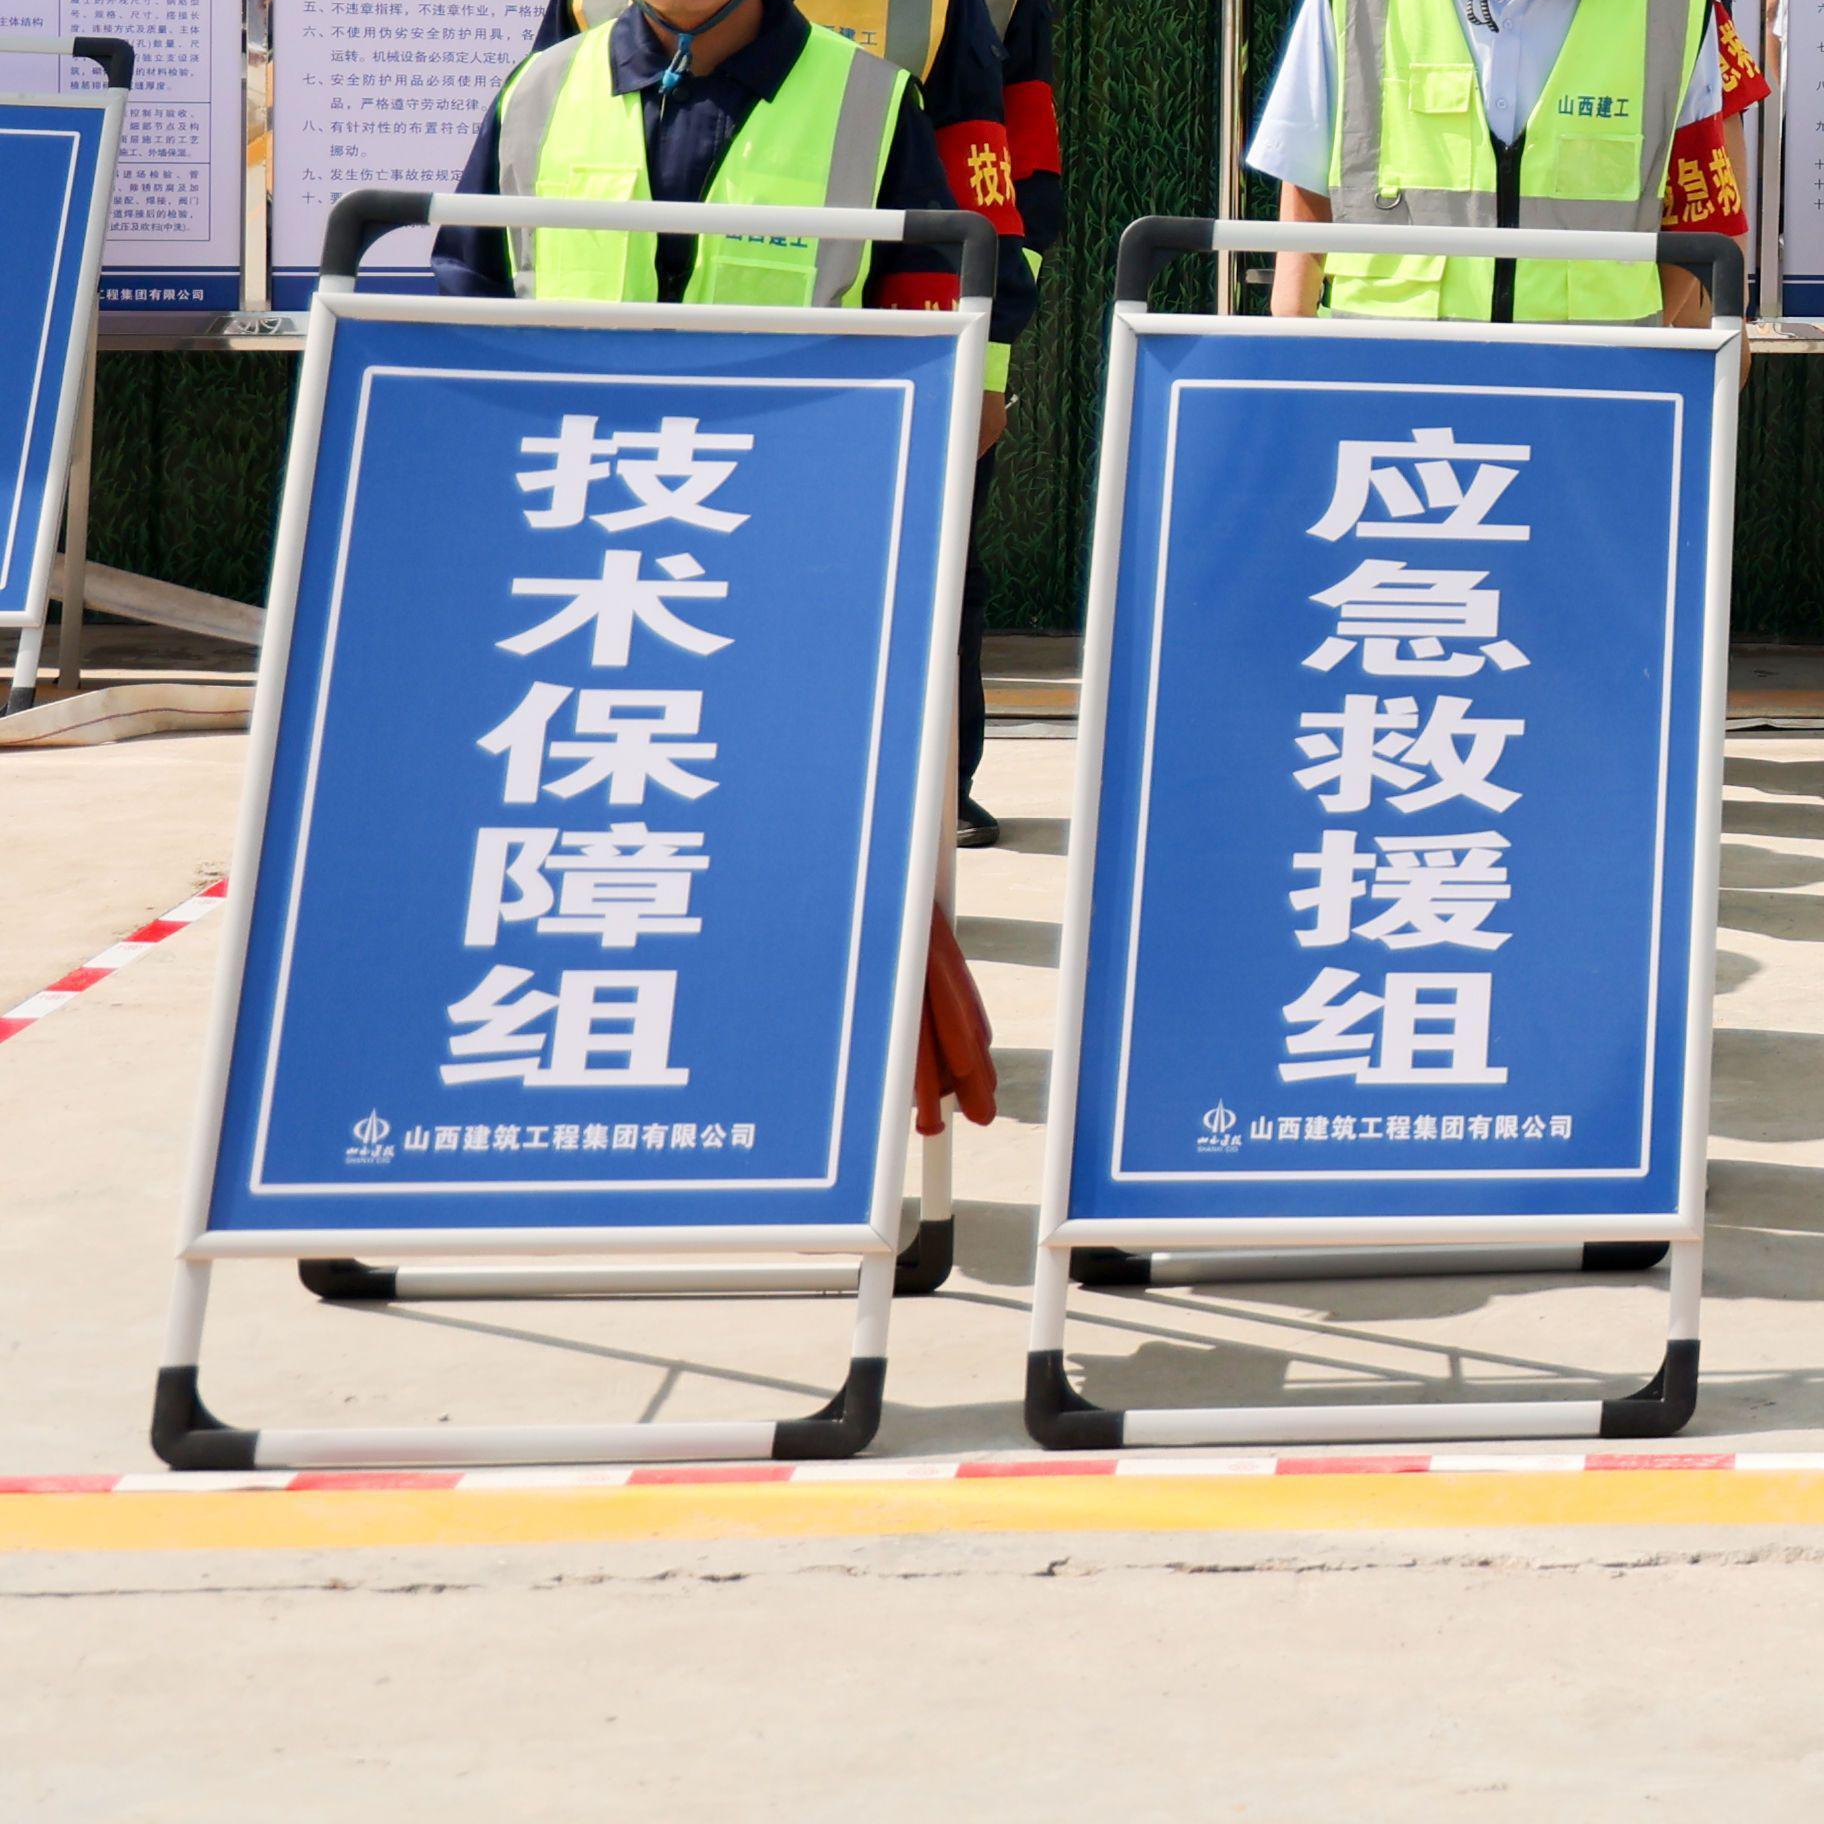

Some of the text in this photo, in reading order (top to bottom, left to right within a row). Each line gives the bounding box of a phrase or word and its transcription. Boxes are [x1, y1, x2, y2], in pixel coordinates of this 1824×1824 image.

[1558, 94, 1629, 119] 山西建工
[329, 143, 368, 159] 挪动。
[440, 414, 755, 1087] 技术保障组
[1278, 427, 1532, 1085] 应急救援组
[403, 1122, 758, 1152] 山西建筑工程集团有限公司
[1250, 1113, 1574, 1142] 山西建筑工程集团有限公司
